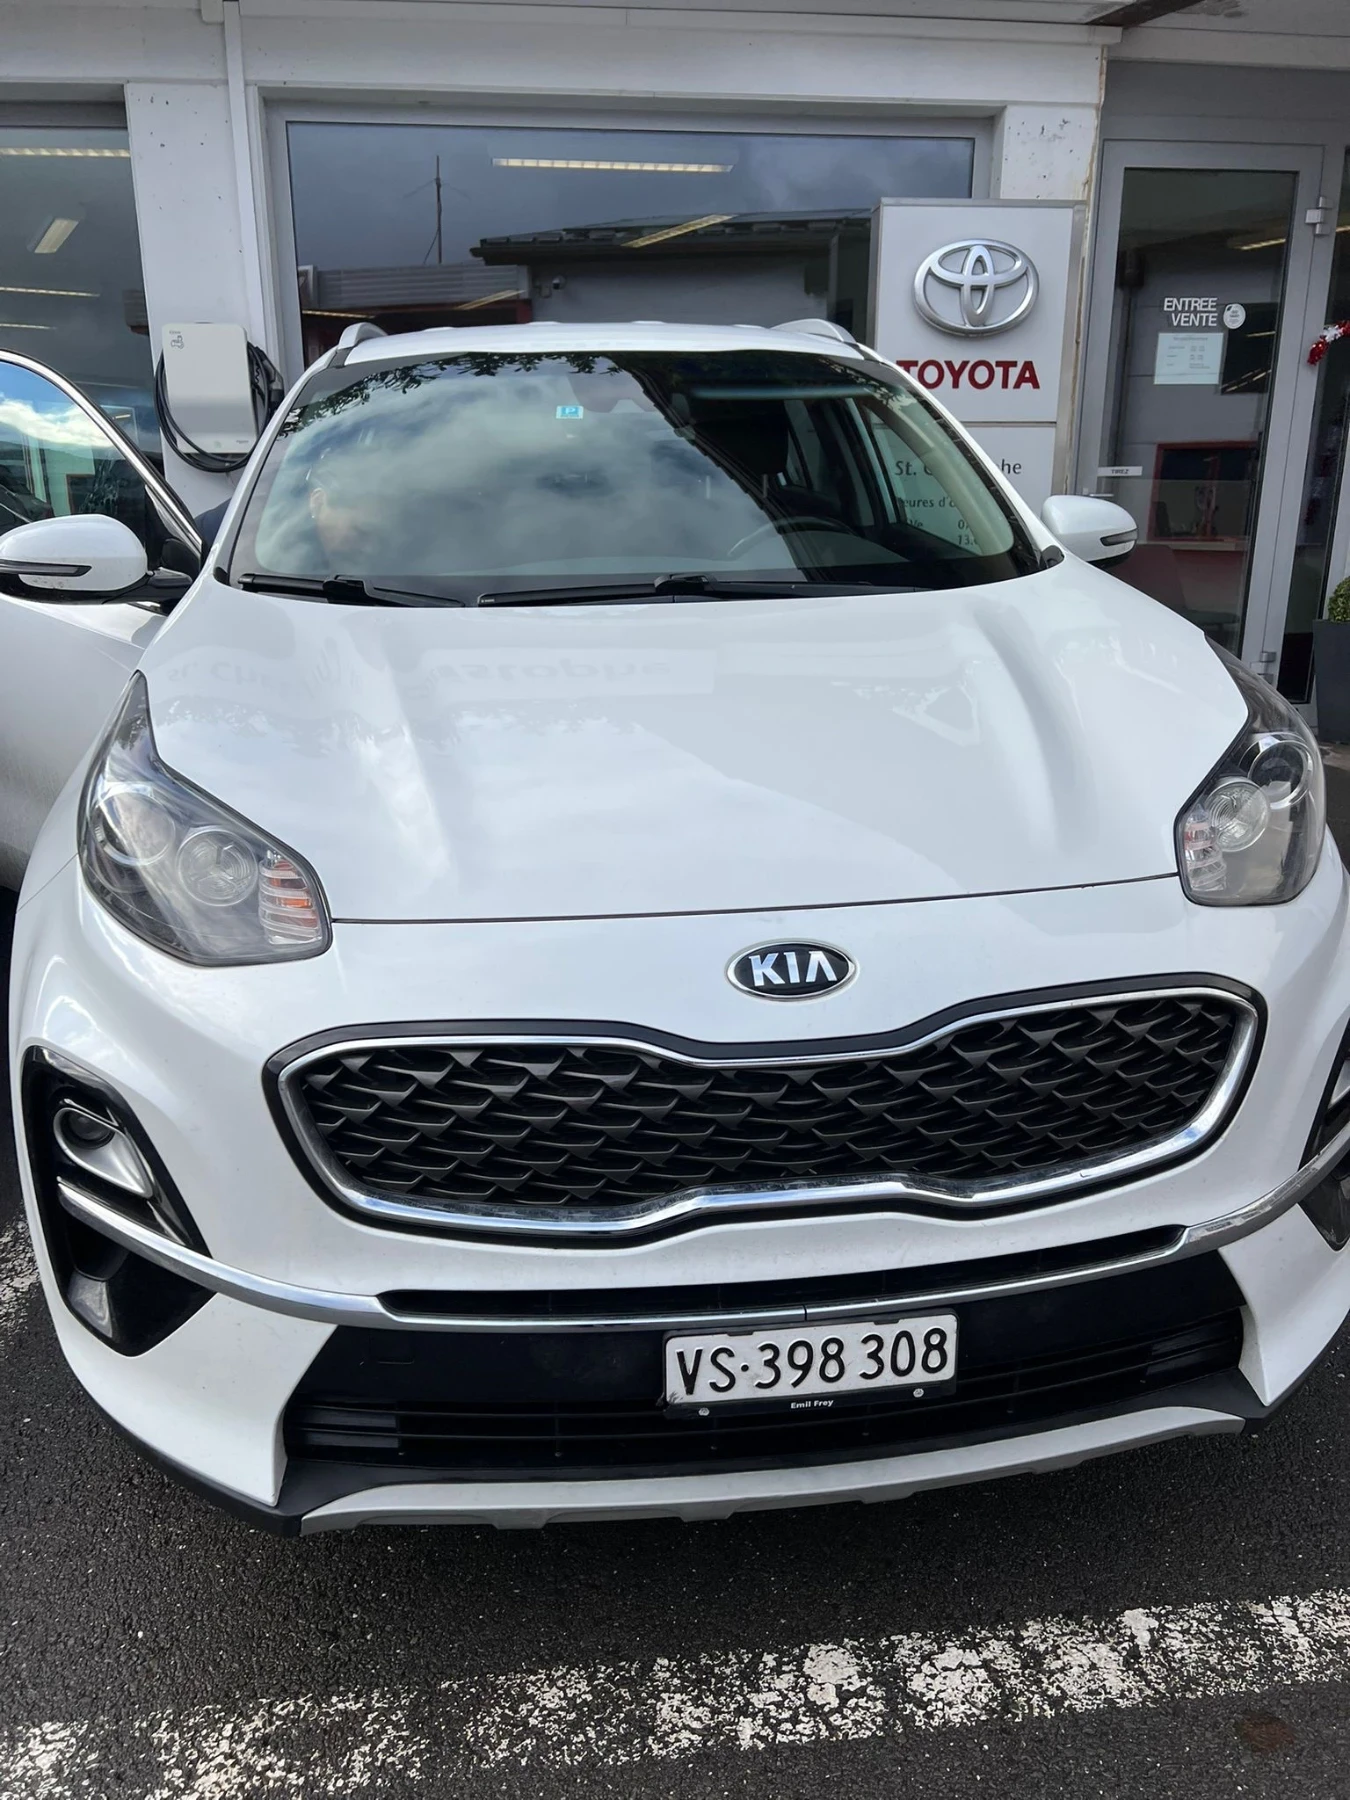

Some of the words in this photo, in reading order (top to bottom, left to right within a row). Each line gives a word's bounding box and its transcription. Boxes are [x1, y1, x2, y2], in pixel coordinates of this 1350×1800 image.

[1163, 297, 1218, 311] ENTREE
[1171, 312, 1218, 327] VENTE
[895, 359, 1040, 390] TOYOTA
[895, 460, 917, 476] St.
[748, 950, 838, 987] KIA
[859, 1326, 949, 1380] 308
[790, 1400, 812, 1409] Emil
[813, 1399, 834, 1407] Frey
